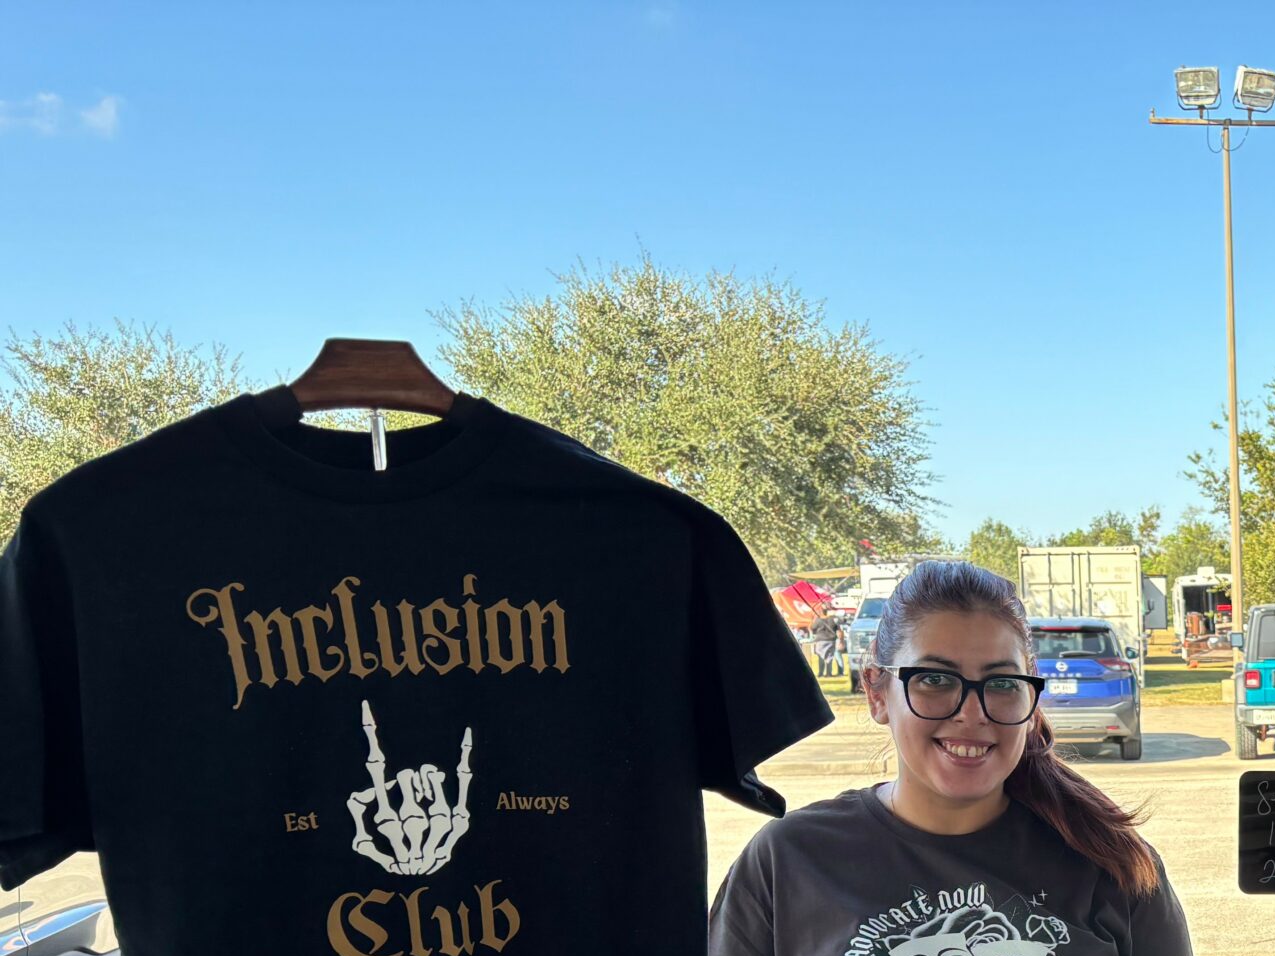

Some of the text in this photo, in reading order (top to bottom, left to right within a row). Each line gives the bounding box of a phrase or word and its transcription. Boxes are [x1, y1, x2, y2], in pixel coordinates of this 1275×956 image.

[186, 574, 572, 710] Inclusion
[495, 790, 570, 812] Always
[283, 811, 320, 832] Est
[1268, 820, 1275, 846] 1
